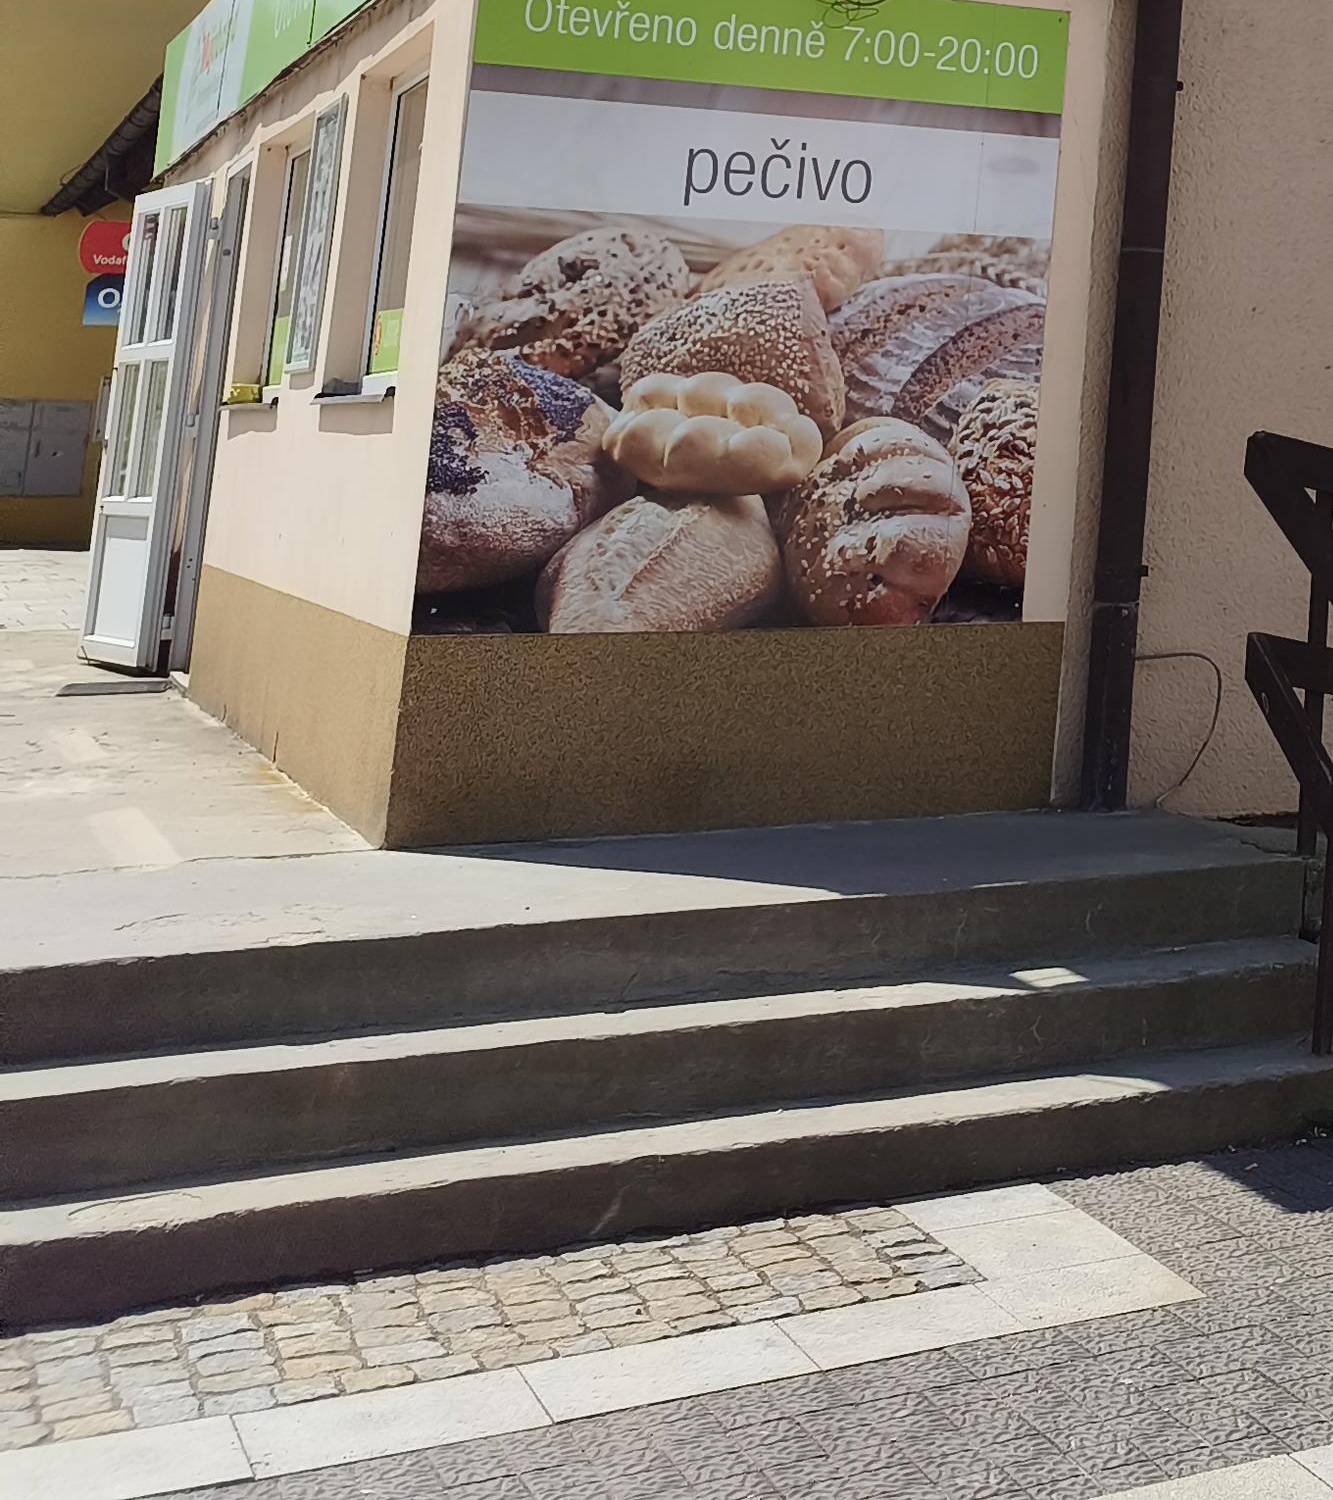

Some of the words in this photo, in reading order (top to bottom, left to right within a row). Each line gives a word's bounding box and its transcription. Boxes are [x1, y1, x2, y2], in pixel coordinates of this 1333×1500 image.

[713, 12, 826, 58] denně
[842, 25, 1039, 79] 7:00-20:00
[683, 137, 872, 206] pečivo
